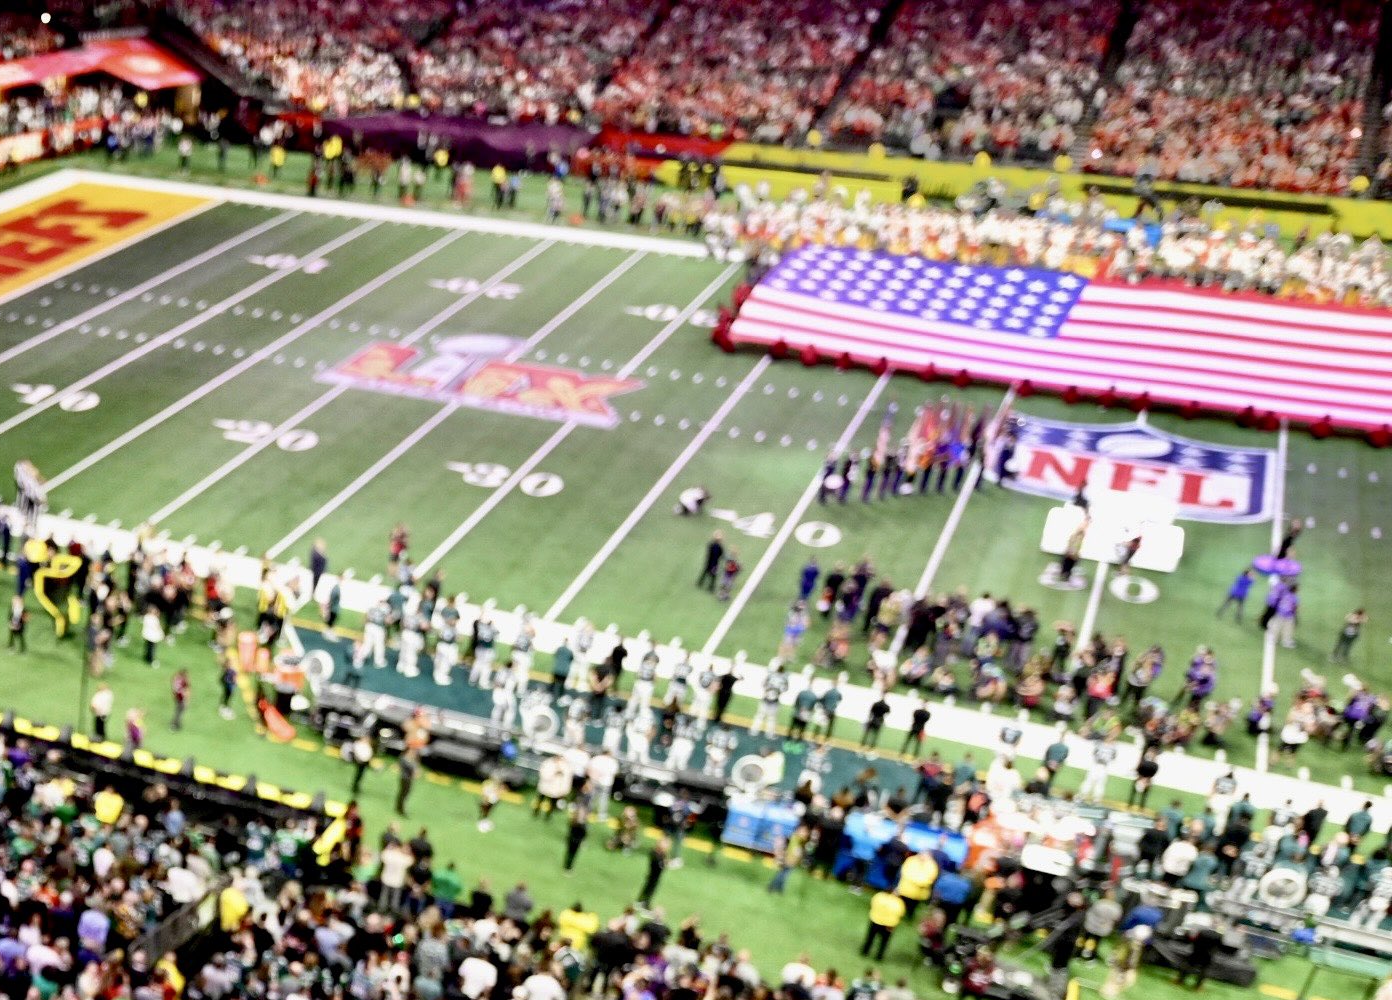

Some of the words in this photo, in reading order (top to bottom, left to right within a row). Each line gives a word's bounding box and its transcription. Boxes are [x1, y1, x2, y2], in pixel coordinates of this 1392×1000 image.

[223, 420, 320, 452] 20
[463, 462, 565, 498] 30
[1027, 450, 1234, 509] NFL
[730, 512, 843, 548] 40
